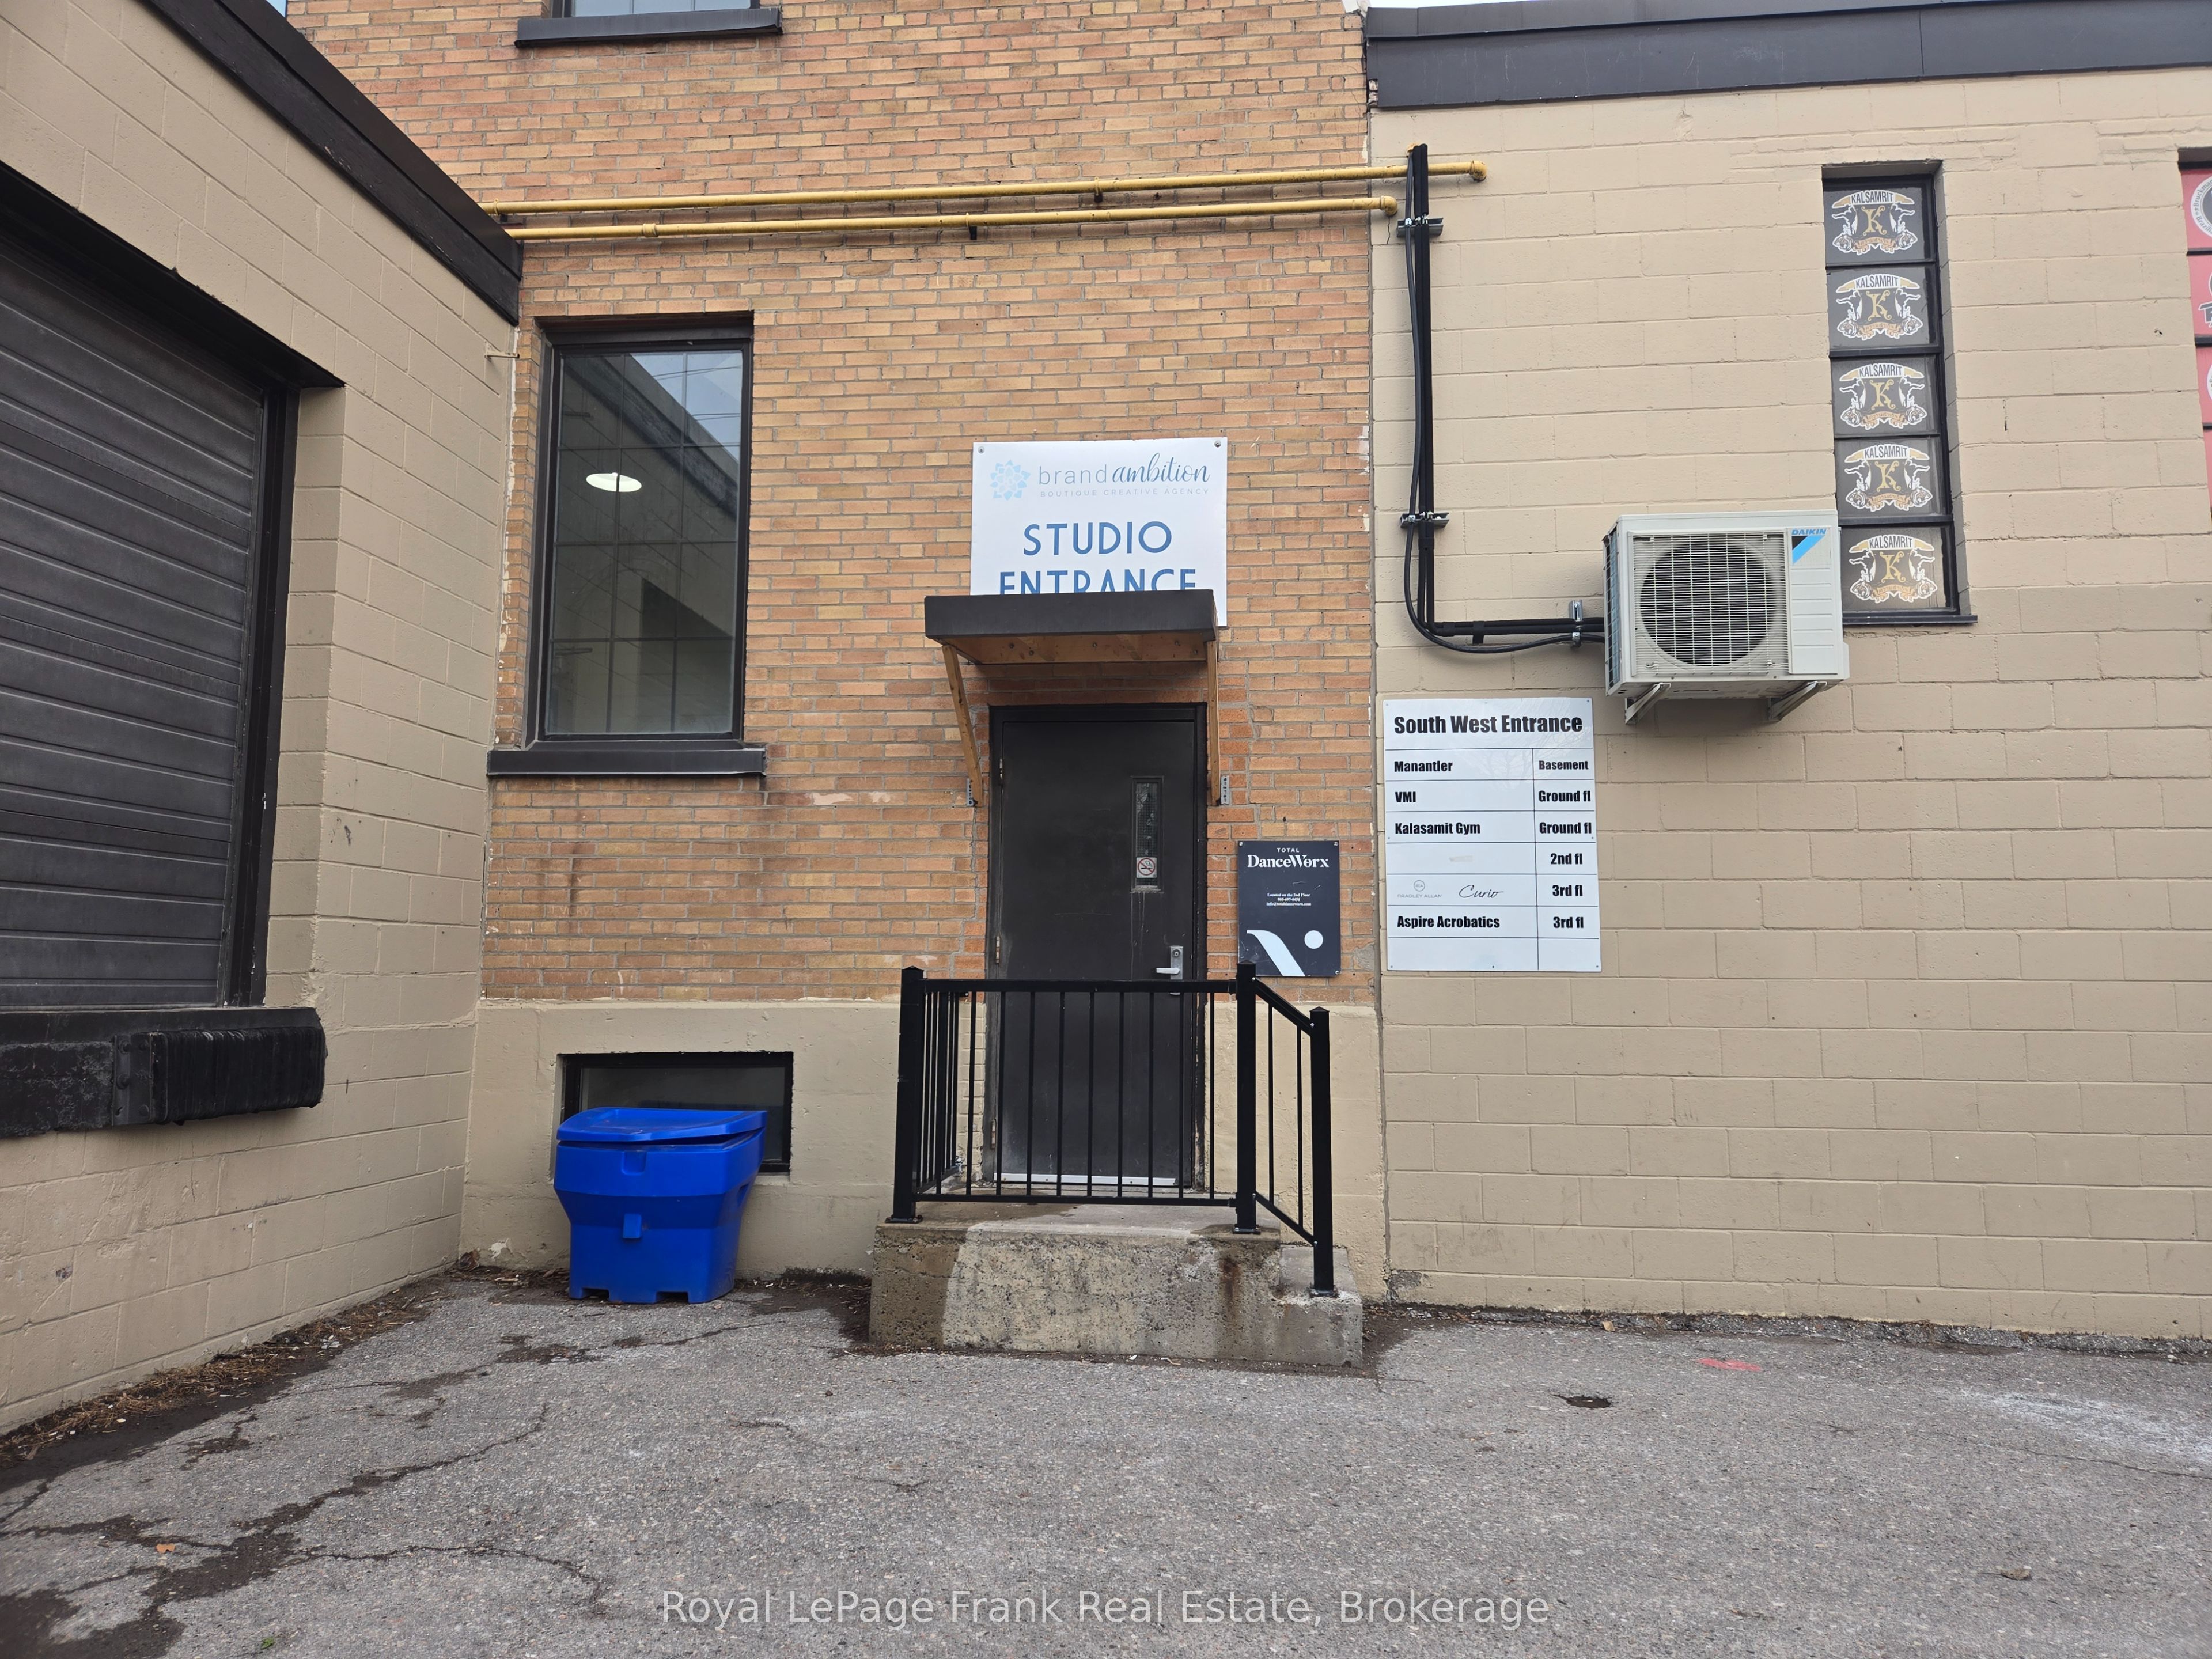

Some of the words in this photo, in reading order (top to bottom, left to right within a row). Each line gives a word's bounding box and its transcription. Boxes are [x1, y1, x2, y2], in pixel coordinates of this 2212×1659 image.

[1851, 191, 1894, 204] KALSAMRIT
[1861, 206, 1887, 236] K
[1855, 275, 1899, 289] KALSAMRIT
[1866, 290, 1892, 320] K
[1859, 363, 1903, 377] KALSAMRIT
[1869, 378, 1896, 410] K
[1864, 445, 1908, 459] KALSAMRIT
[1039, 464, 1107, 485] brand
[1112, 452, 1210, 483] ambition
[1876, 461, 1901, 493] K
[1024, 521, 1172, 556] STUDIO
[1869, 535, 1912, 549] KALSAMRIT
[1880, 551, 1906, 582] K
[999, 569, 1196, 595] ENTRANCE
[1394, 716, 1446, 734] South
[1450, 715, 1498, 733] West
[1501, 715, 1583, 733] Entrance
[1394, 760, 1453, 772] Manantler
[1539, 760, 1589, 770] Basement
[1395, 791, 1416, 803] VMI
[1539, 791, 1581, 802] Ground
[1583, 790, 1591, 802] fl
[1395, 823, 1453, 834] Kalasamit
[1456, 823, 1480, 835] Gym
[1539, 823, 1581, 834] Ground
[1584, 822, 1592, 834] fl
[1247, 854, 1330, 868] DanceWorx
[1550, 853, 1572, 865] 2nd
[1575, 853, 1583, 865] fl
[1459, 884, 1504, 898] Curio
[1552, 885, 1573, 896] 3rd
[1575, 885, 1583, 896] fl
[1397, 916, 1434, 929] Aspire
[1437, 916, 1500, 928] Acrobatics
[1553, 917, 1573, 928] 3rd
[1575, 916, 1584, 928] fl
